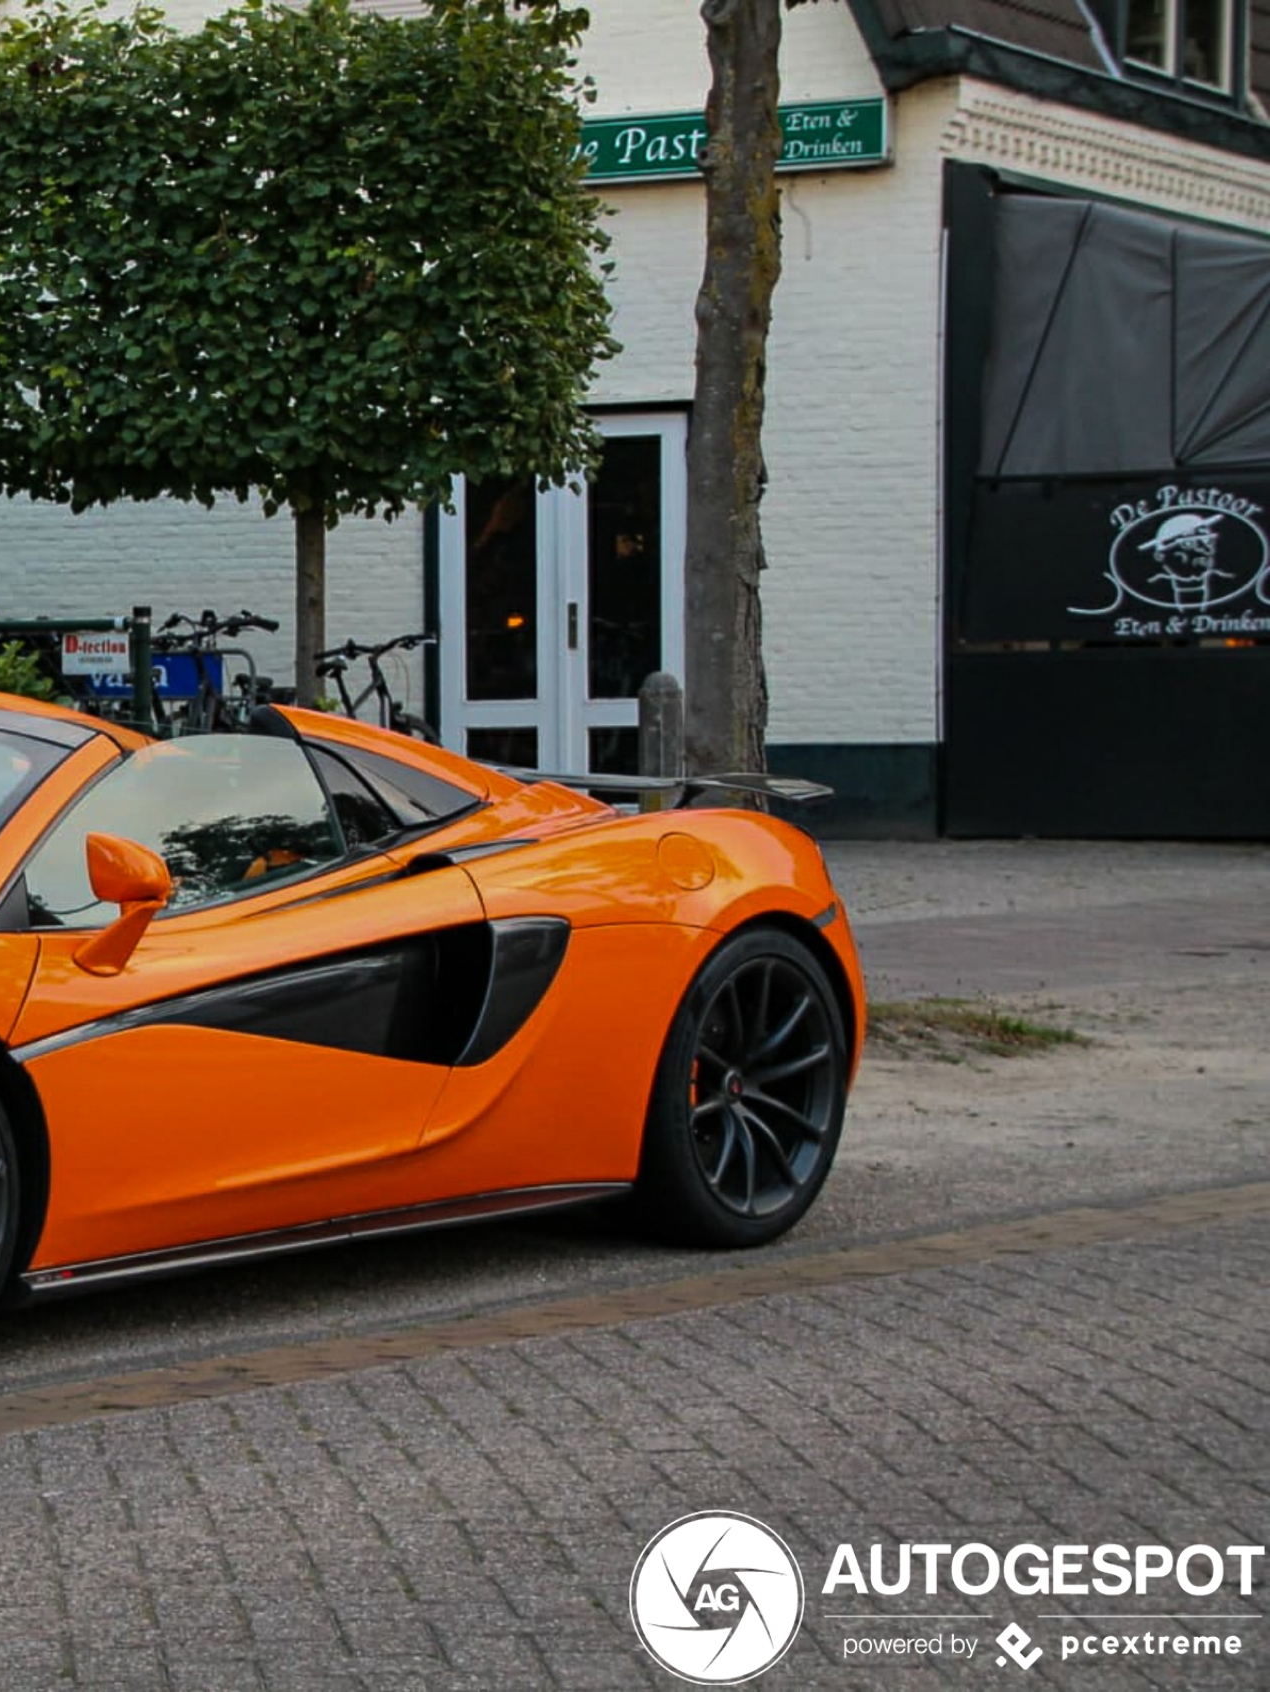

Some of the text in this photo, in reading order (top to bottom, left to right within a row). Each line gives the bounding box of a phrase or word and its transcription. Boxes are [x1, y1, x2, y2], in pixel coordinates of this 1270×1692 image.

[786, 109, 859, 131] Eten &
[783, 132, 863, 160] Drinken
[1110, 485, 1262, 530] De Pastoor
[1114, 617, 1161, 636] Eten
[1165, 616, 1187, 634] &
